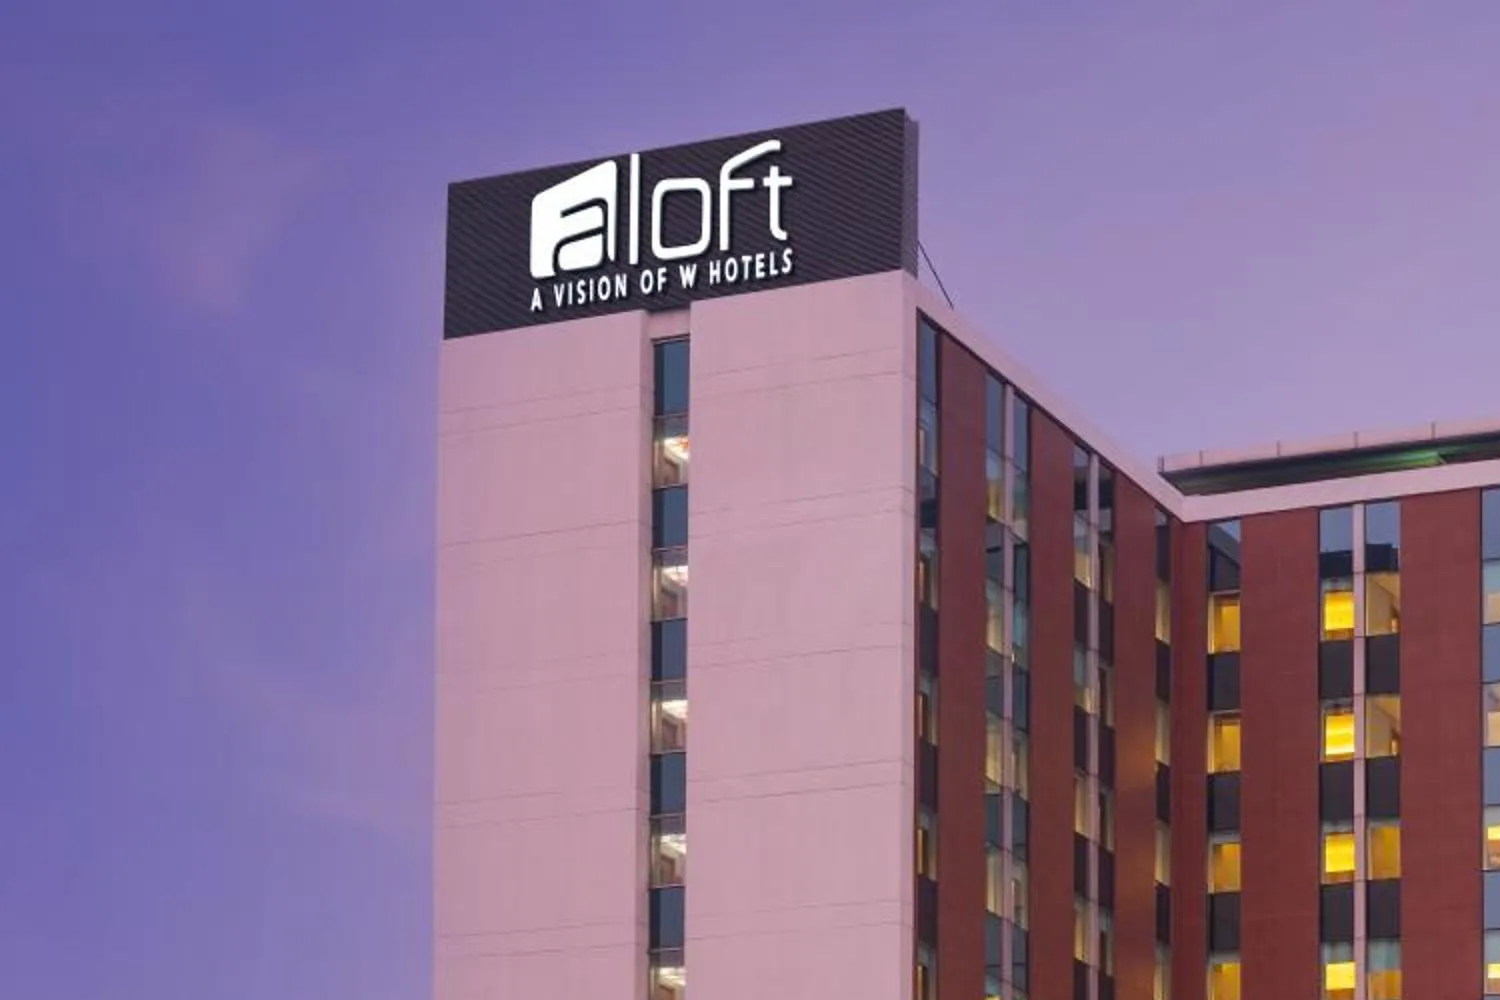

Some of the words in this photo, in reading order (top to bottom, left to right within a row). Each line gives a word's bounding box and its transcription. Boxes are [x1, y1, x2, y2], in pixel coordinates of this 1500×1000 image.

[529, 139, 793, 279] aloft
[530, 287, 543, 312] A
[553, 275, 627, 308] VISION
[639, 267, 667, 294] OF
[679, 263, 697, 289] W
[709, 247, 793, 285] HOTELS
